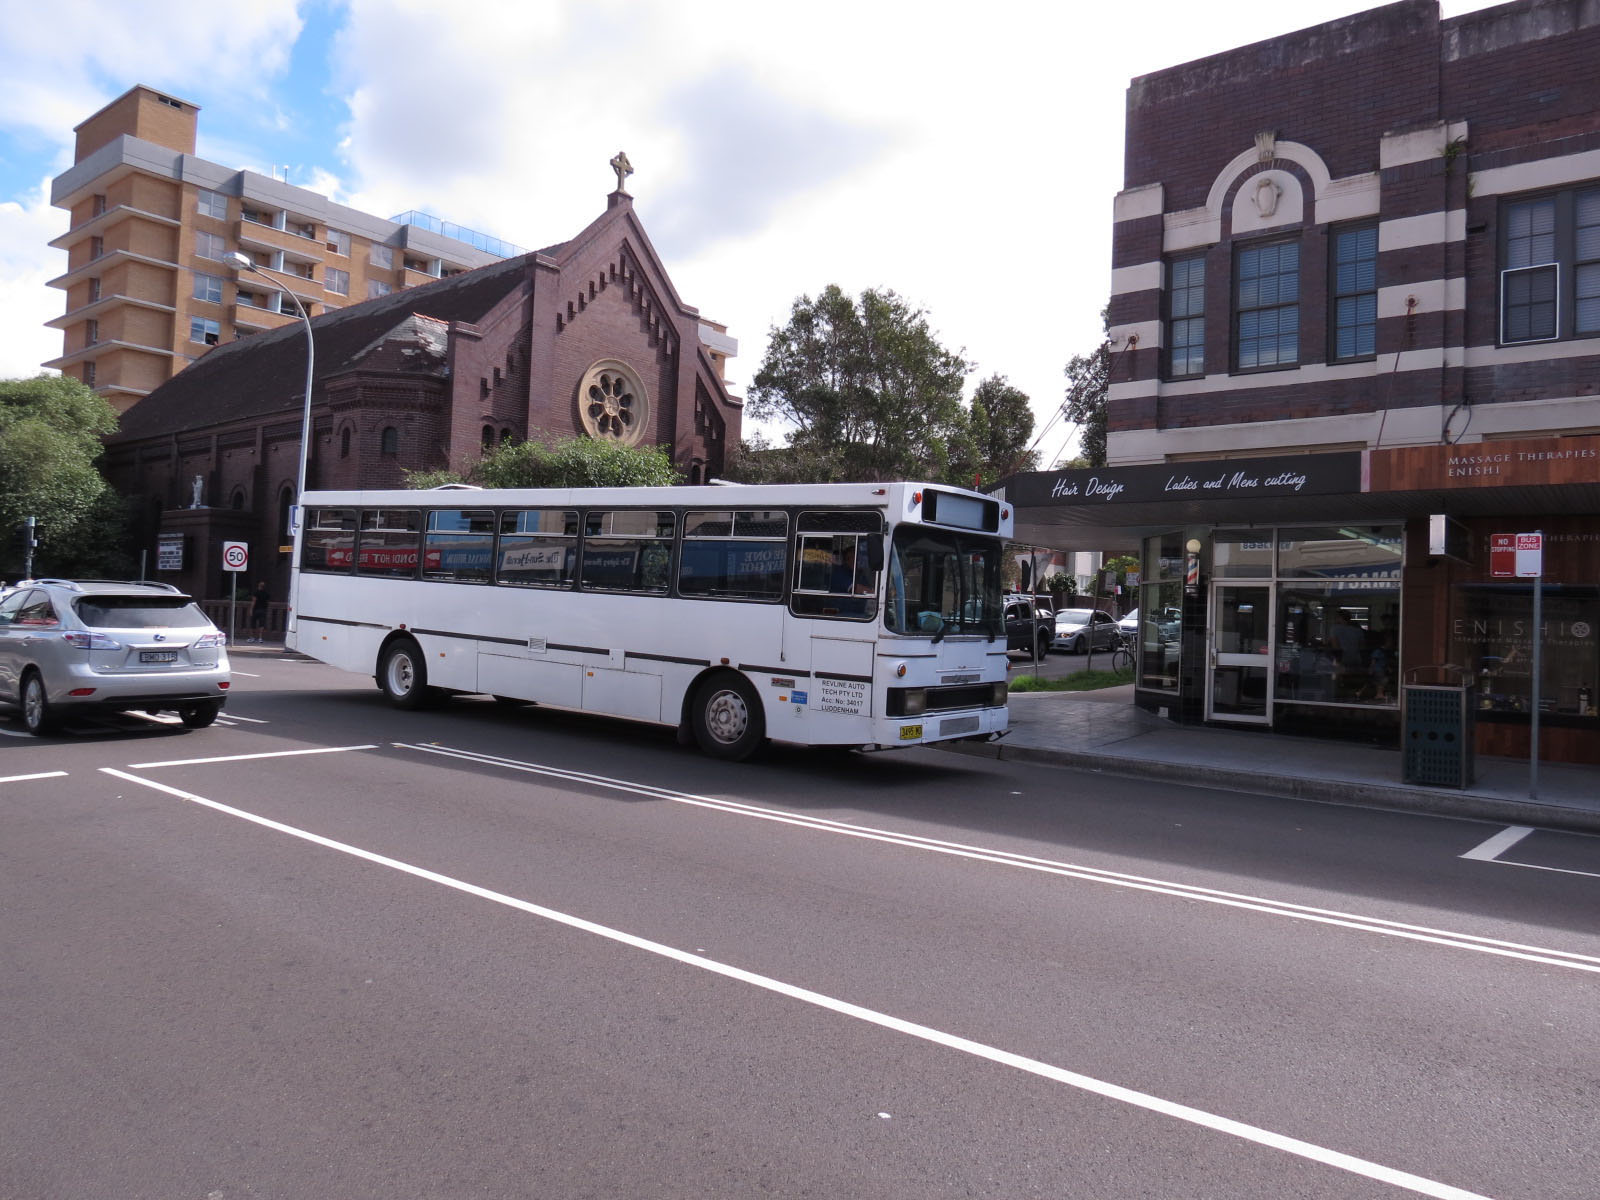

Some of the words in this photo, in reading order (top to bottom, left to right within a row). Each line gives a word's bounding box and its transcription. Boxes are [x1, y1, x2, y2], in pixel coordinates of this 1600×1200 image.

[1517, 449, 1597, 462] THERAPIES
[1448, 465, 1501, 477] ENISHI
[1165, 475, 1199, 492] Ladies
[1203, 473, 1223, 489] and
[1226, 471, 1259, 490] Mens
[1264, 472, 1307, 492] cutting
[1051, 478, 1079, 498] Hair
[1085, 477, 1126, 500] Design
[1497, 538, 1509, 546] NO
[1520, 536, 1538, 544] BUS
[229, 551, 244, 562] 50
[822, 680, 847, 689] REVLINE
[848, 682, 865, 690] AUTO
[846, 699, 863, 707] 34017
[821, 705, 859, 714] LUDDENHAM
